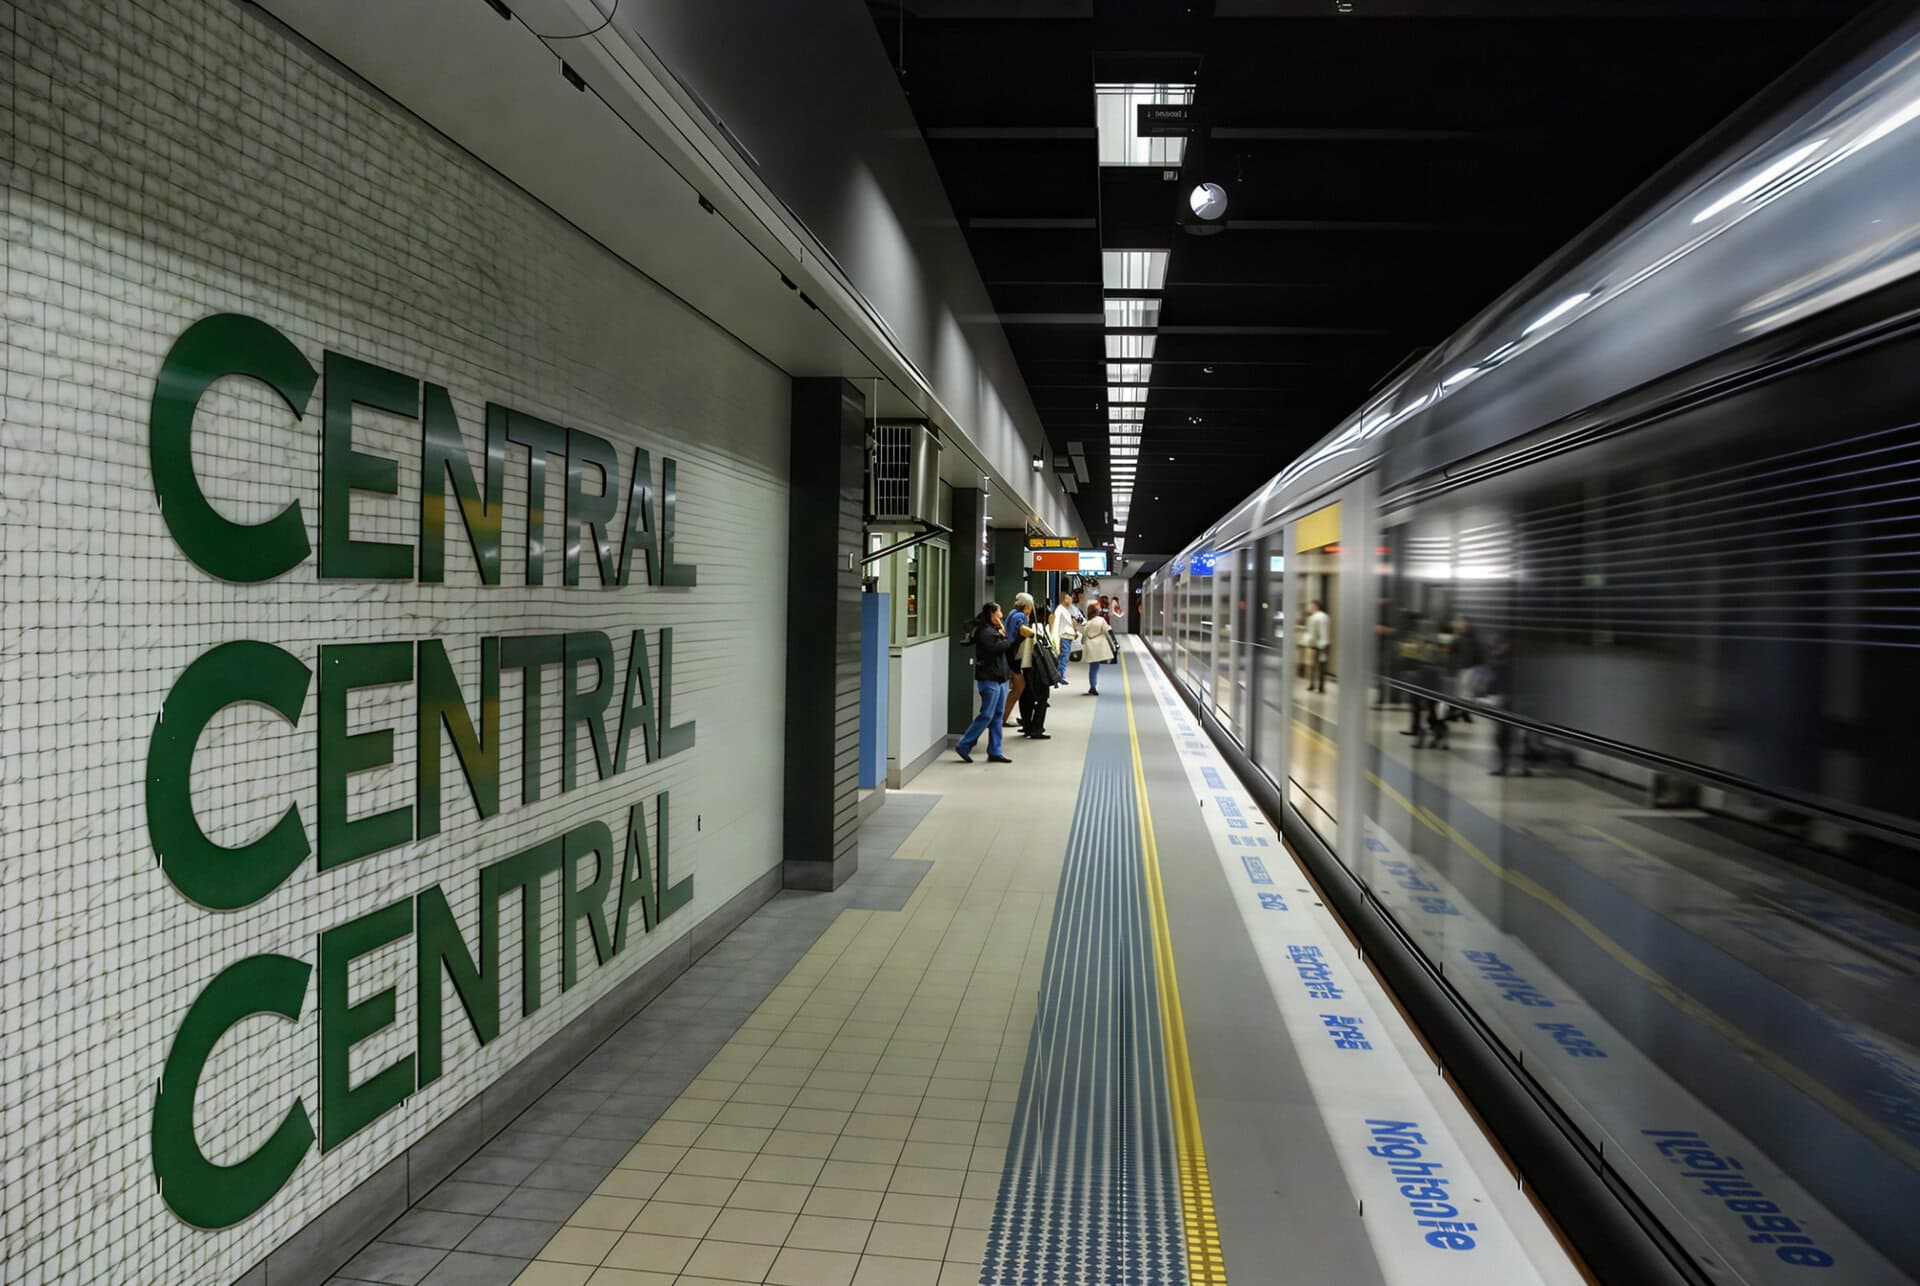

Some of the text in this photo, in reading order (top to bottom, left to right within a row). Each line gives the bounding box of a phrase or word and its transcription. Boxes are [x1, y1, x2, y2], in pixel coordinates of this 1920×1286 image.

[150, 312, 696, 586] CENTRAL
[147, 628, 696, 909] CENTRAL
[151, 790, 694, 1228] CENTRAL
